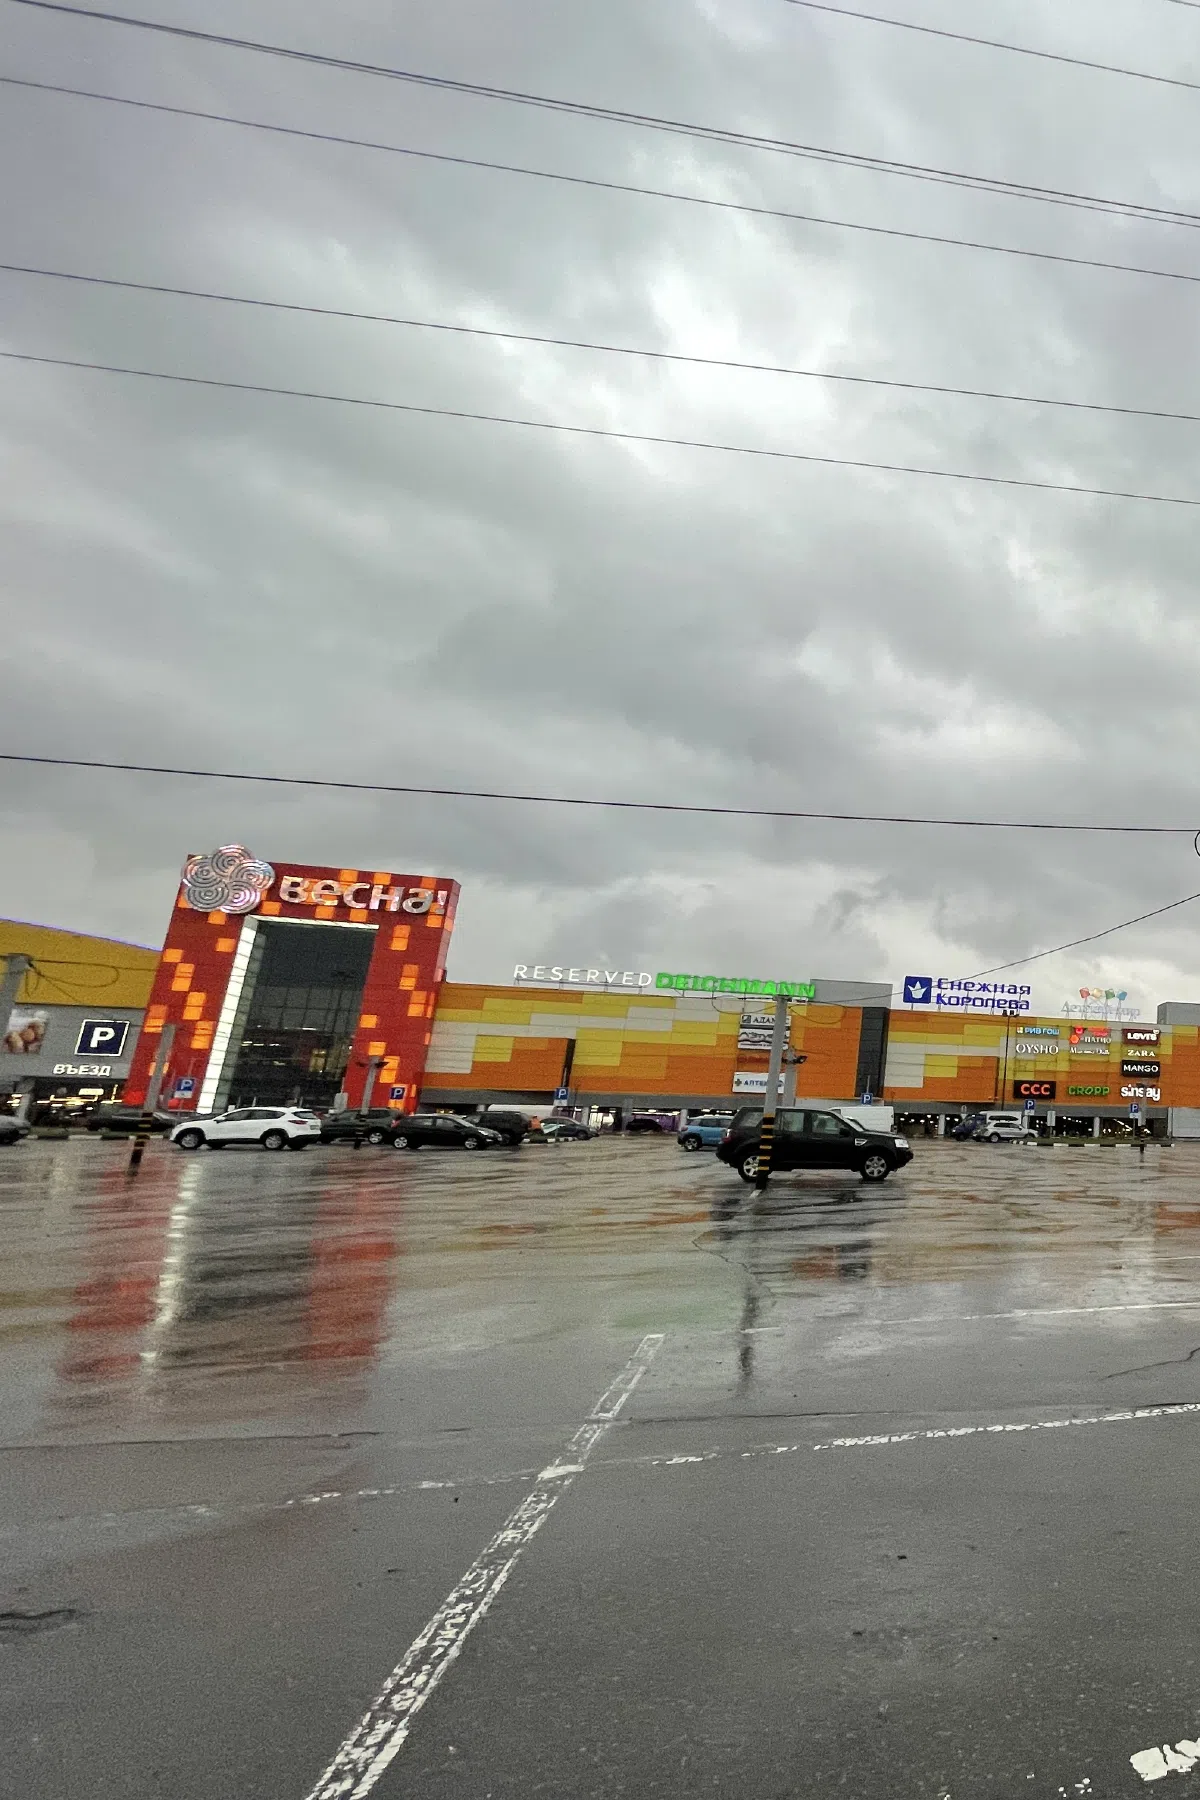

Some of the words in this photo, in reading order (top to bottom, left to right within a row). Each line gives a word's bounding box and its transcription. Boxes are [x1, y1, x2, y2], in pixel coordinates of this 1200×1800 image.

[513, 964, 652, 986] RESERVED
[656, 972, 816, 998] DEICHMANN
[937, 978, 1031, 995] Снежная
[935, 993, 1030, 1010] Королева
[1024, 1027, 1042, 1035] РИВ
[1016, 1043, 1059, 1055] OYSHO
[1127, 1049, 1156, 1057] ZARA
[53, 1063, 111, 1077] ВЪЕЗД
[1123, 1064, 1159, 1073] MANGO
[1020, 1083, 1051, 1095] CCC
[1068, 1085, 1110, 1096] CROPP
[1120, 1083, 1160, 1102] sinsay
